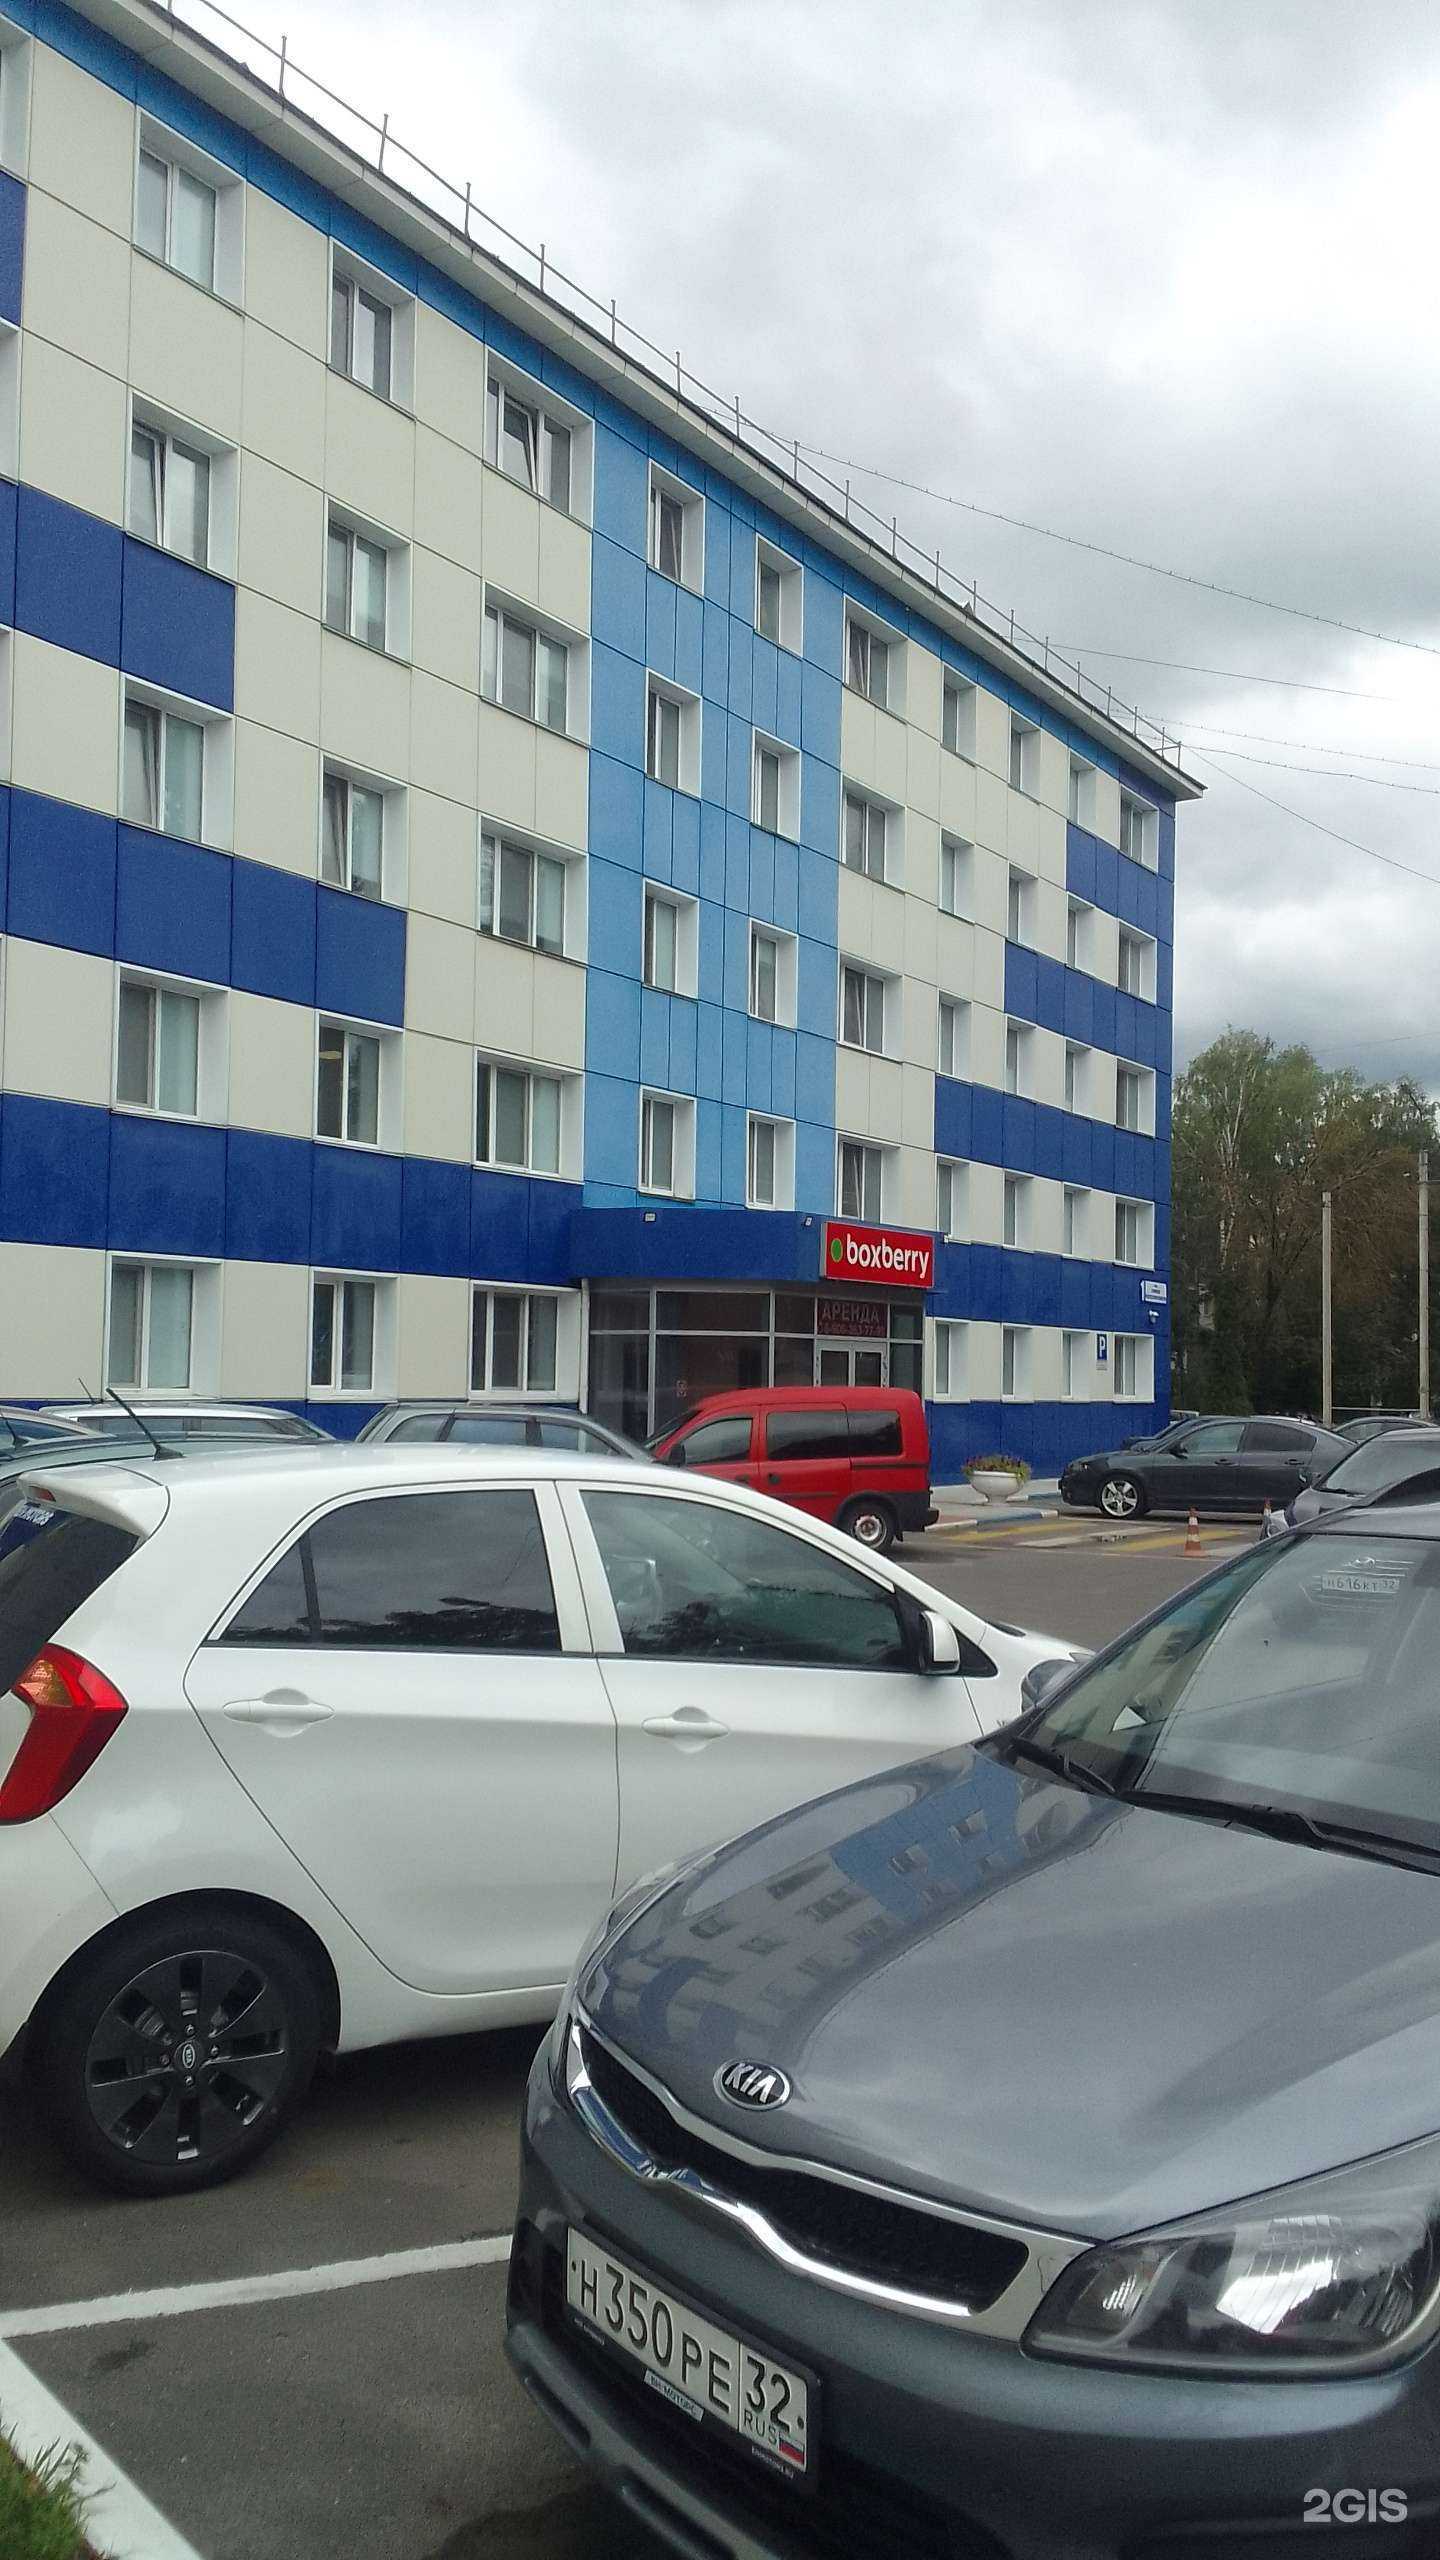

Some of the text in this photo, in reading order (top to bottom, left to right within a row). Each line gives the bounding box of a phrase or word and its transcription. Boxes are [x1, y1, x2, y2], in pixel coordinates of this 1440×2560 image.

[847, 1234, 929, 1278] boxberry
[822, 1302, 879, 1323] АРЕНДА
[724, 2063, 777, 2104] KIA
[743, 2408, 778, 2446] RUS
